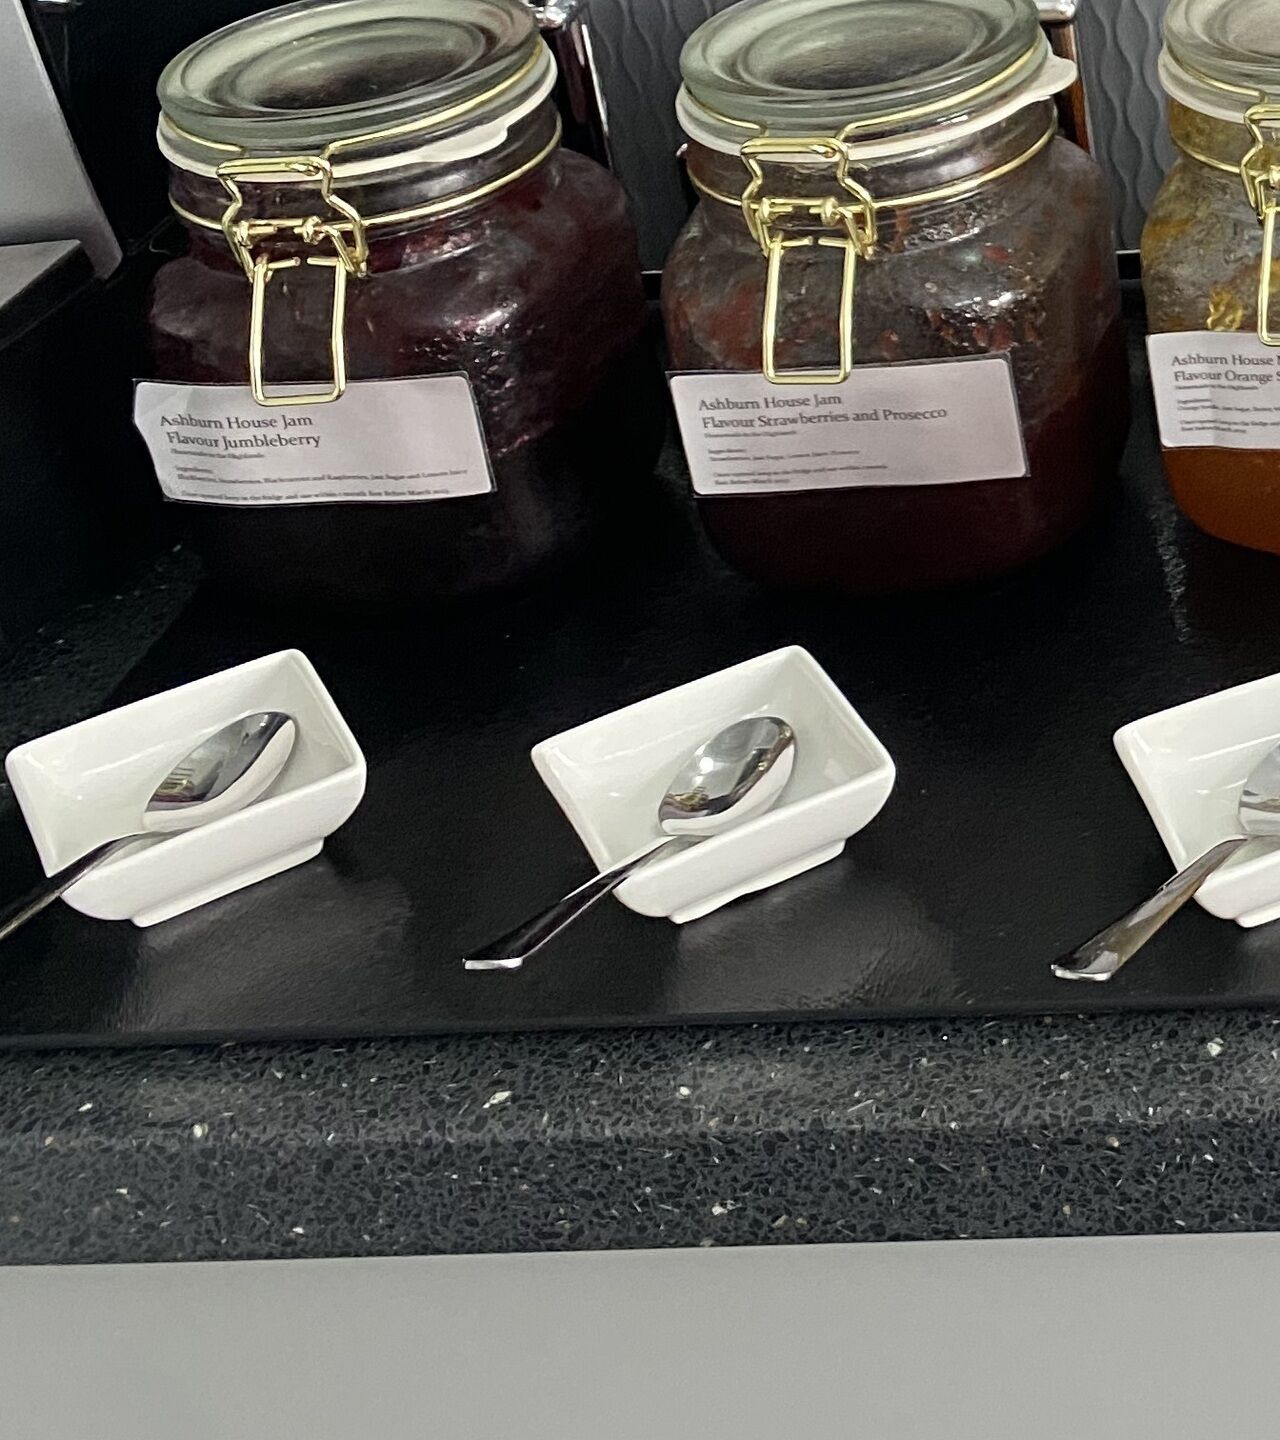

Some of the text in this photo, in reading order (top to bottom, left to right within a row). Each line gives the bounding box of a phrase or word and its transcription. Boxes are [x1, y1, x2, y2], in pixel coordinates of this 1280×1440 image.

[1171, 354, 1229, 366] Ashburn
[1232, 354, 1274, 366] House
[1174, 371, 1222, 382] Flavour
[1224, 370, 1274, 384] Orange
[698, 394, 842, 412] Ashburn House Jam
[160, 414, 313, 430] Ashburn House Jam
[702, 407, 948, 430] Flavour Strawberries and Prosecco
[167, 432, 321, 451] Flavour Jumbleberry
